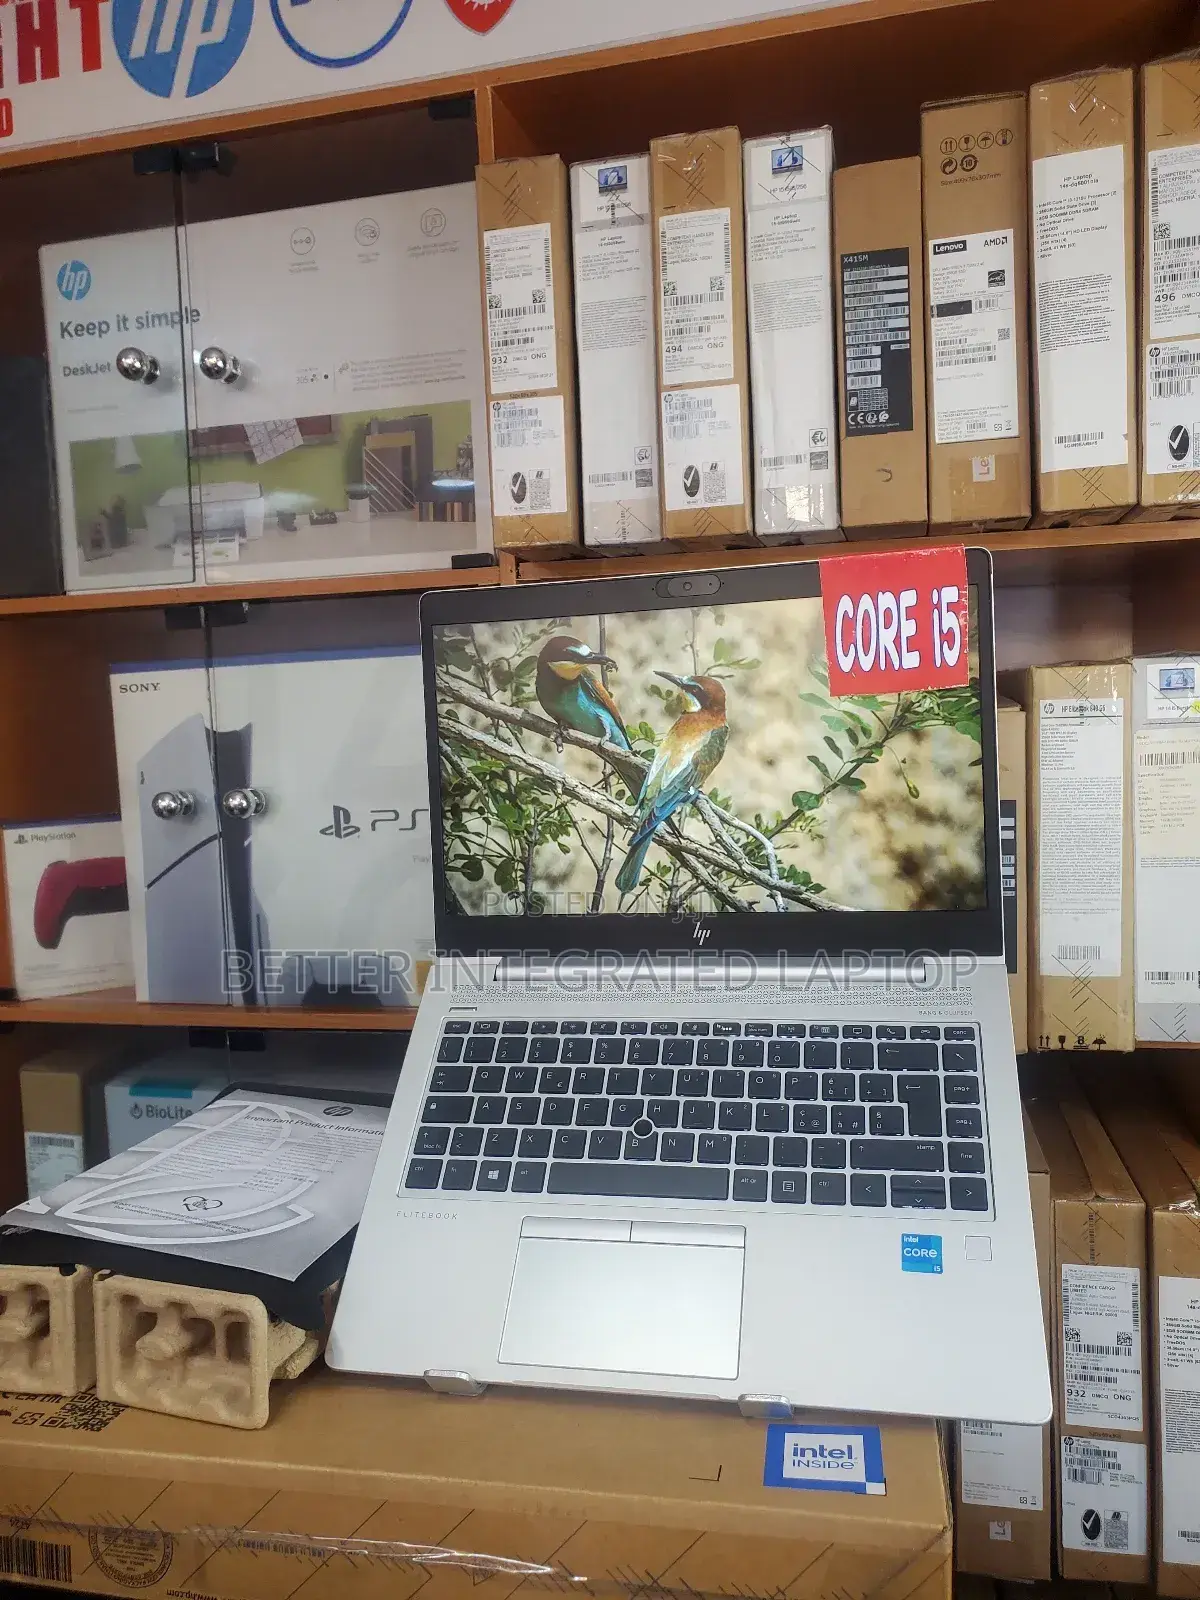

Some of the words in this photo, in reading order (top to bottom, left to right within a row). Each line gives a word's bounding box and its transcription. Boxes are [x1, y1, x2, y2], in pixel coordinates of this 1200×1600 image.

[0, 0, 107, 89] HT
[936, 243, 964, 253] Lenovo
[984, 238, 1002, 247] AMD
[843, 254, 869, 264] X415M
[62, 260, 88, 300] hp
[1155, 292, 1176, 303] 496
[60, 320, 111, 340] Keep
[116, 313, 130, 333] it
[135, 306, 201, 330] simple
[665, 345, 683, 353] 494
[707, 341, 724, 349] ONG
[491, 355, 508, 364] 932
[530, 352, 547, 360] ONG
[62, 361, 112, 378] DeskJet
[835, 588, 921, 673] CORE
[931, 585, 961, 668] i5
[119, 682, 161, 694] SONY
[1061, 705, 1068, 713] HP
[30, 832, 77, 844] PlayStation
[692, 921, 711, 945] hp
[145, 1104, 193, 1120] BioLite
[244, 1114, 294, 1125] Important
[294, 1120, 334, 1131] Product
[903, 1235, 919, 1243] intel
[1066, 1388, 1086, 1398] 932
[1113, 1393, 1132, 1401] ONG
[792, 1443, 852, 1460] intel
[166, 1589, 219, 1600] www.hp.com
